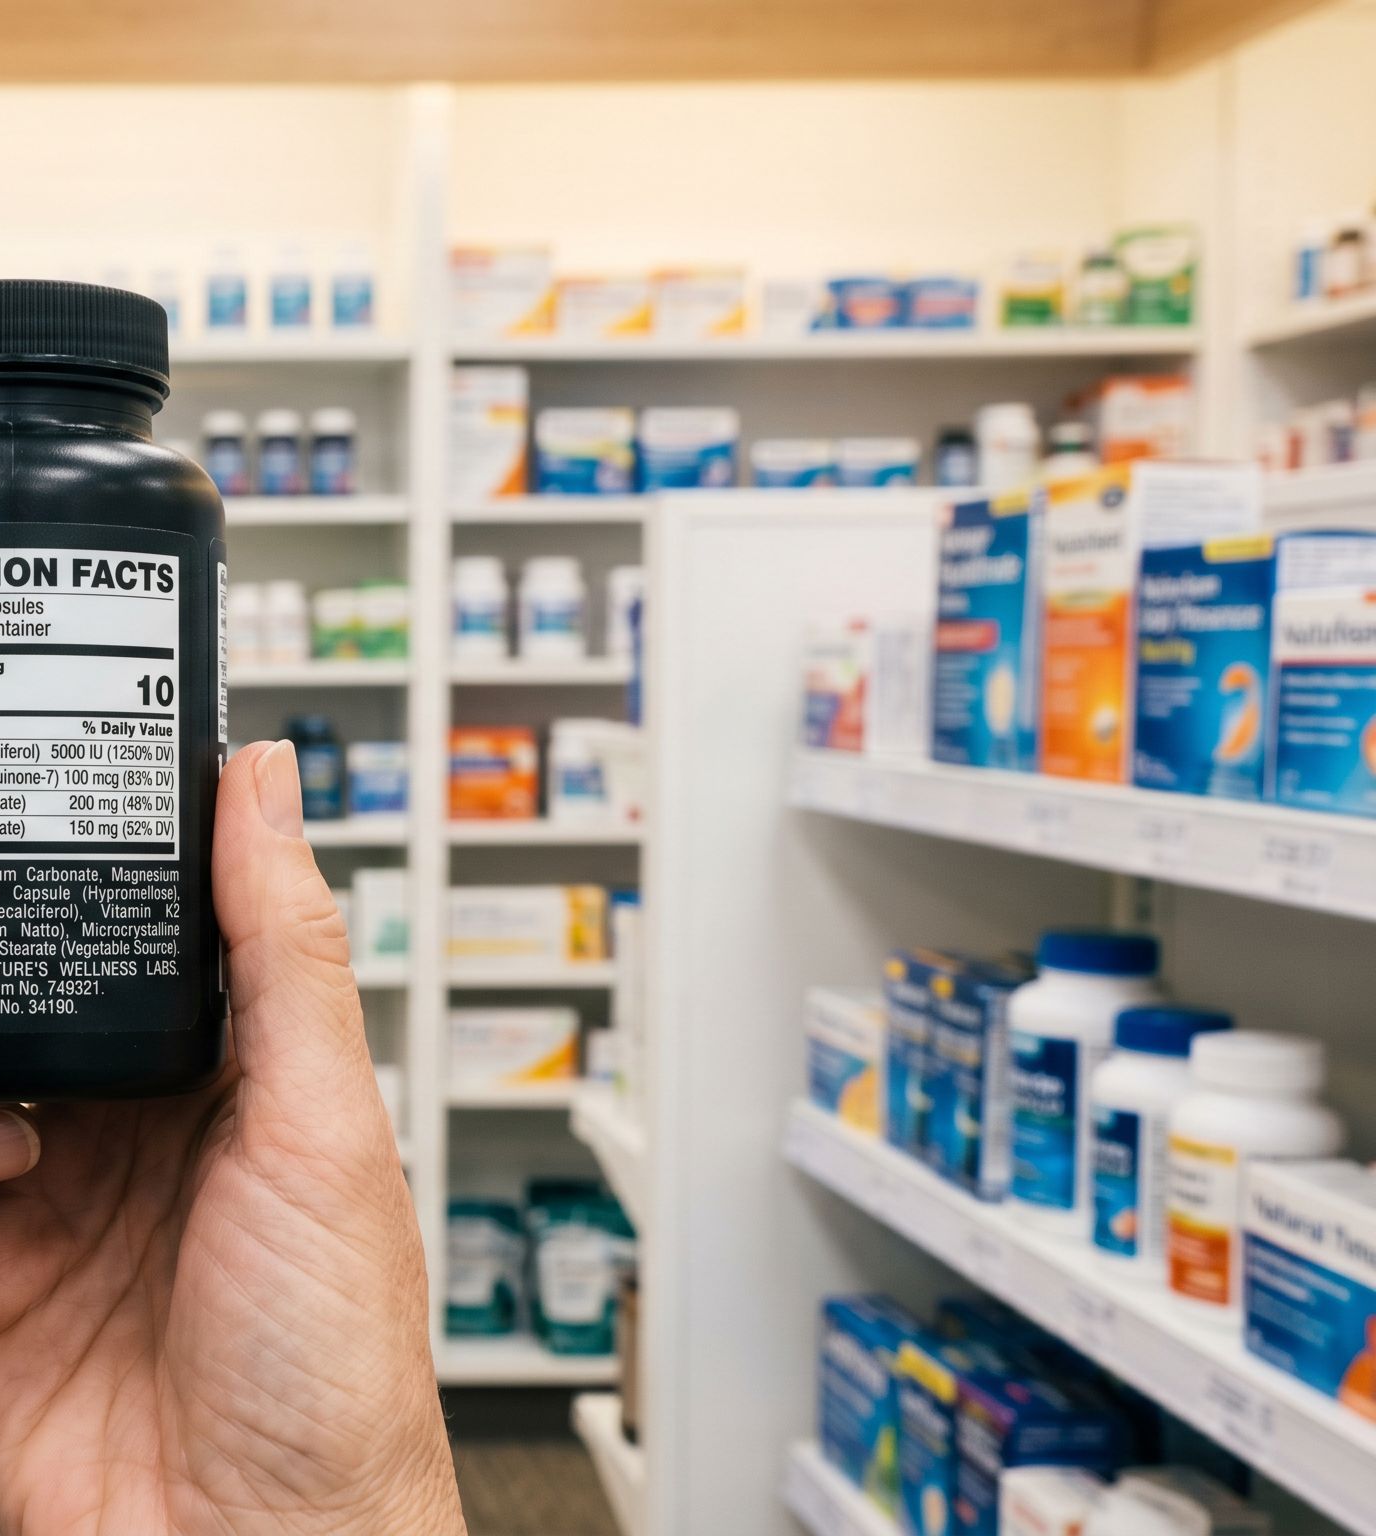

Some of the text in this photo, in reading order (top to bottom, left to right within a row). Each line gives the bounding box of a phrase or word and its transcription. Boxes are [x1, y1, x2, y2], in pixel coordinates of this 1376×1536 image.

[72, 558, 174, 593] FACTS
[137, 675, 174, 707] 10
[82, 720, 173, 738] % Daily Value
[51, 744, 85, 759] 5000
[90, 744, 103, 760] IU
[107, 744, 153, 764] (1250%
[156, 746, 174, 765] DV)
[64, 769, 89, 785] 100
[93, 773, 119, 789] mcg
[123, 770, 152, 789] (83%
[156, 771, 174, 790] DV)
[69, 795, 94, 810] 200
[98, 798, 118, 814] mg
[122, 795, 152, 814] (48%
[155, 796, 174, 815] DV)
[70, 820, 94, 835] 150
[98, 824, 118, 839] mg
[122, 820, 152, 840] (52%
[156, 821, 174, 840] DV)
[26, 866, 102, 883] Carbonate,
[112, 867, 179, 885] Magnesium
[13, 885, 70, 903] Capsule
[100, 903, 151, 918] Vitamin
[166, 903, 180, 918] K2
[21, 922, 69, 940] Natto),
[82, 922, 180, 939] Microcrystalline
[0, 940, 56, 956] Stearate
[61, 940, 130, 959] (Vegetable
[134, 939, 180, 957] Source).
[59, 961, 137, 976] WELLNESS
[19, 980, 43, 995] No.
[48, 980, 104, 995] 749321.
[0, 999, 24, 1014] No.
[29, 999, 78, 1014] 34190.
